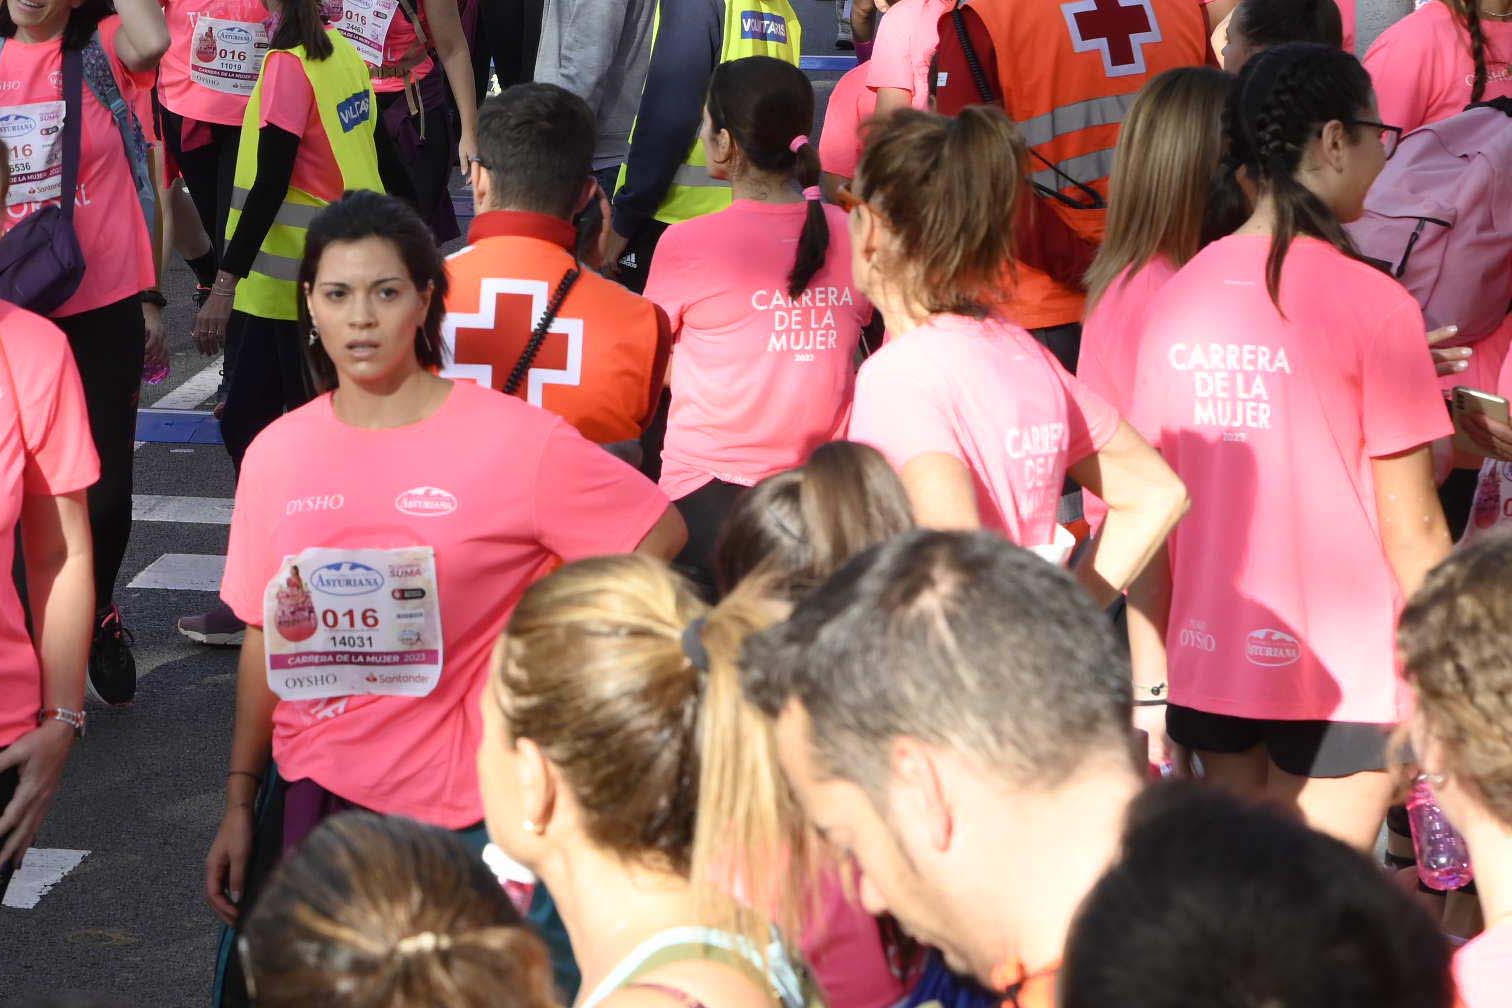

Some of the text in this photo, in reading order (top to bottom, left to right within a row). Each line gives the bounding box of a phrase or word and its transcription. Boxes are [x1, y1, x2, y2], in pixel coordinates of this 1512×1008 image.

[345, 9, 367, 26] 016
[218, 48, 248, 61] 016
[220, 62, 243, 71] 11019
[774, 308, 836, 330] DE LA
[767, 329, 837, 353] MUJER
[1168, 342, 1291, 375] CARRERA
[1193, 371, 1269, 402] DE LA
[1193, 401, 1272, 430] MUJER
[285, 493, 345, 516] OYSHO
[316, 573, 380, 589] ASTURIANA
[321, 608, 380, 630] 016
[329, 635, 376, 649] 14031
[287, 652, 426, 666] CARRERA DE LA MUJER 2023
[284, 672, 338, 690] OYSHO
[378, 673, 429, 686] Santander
